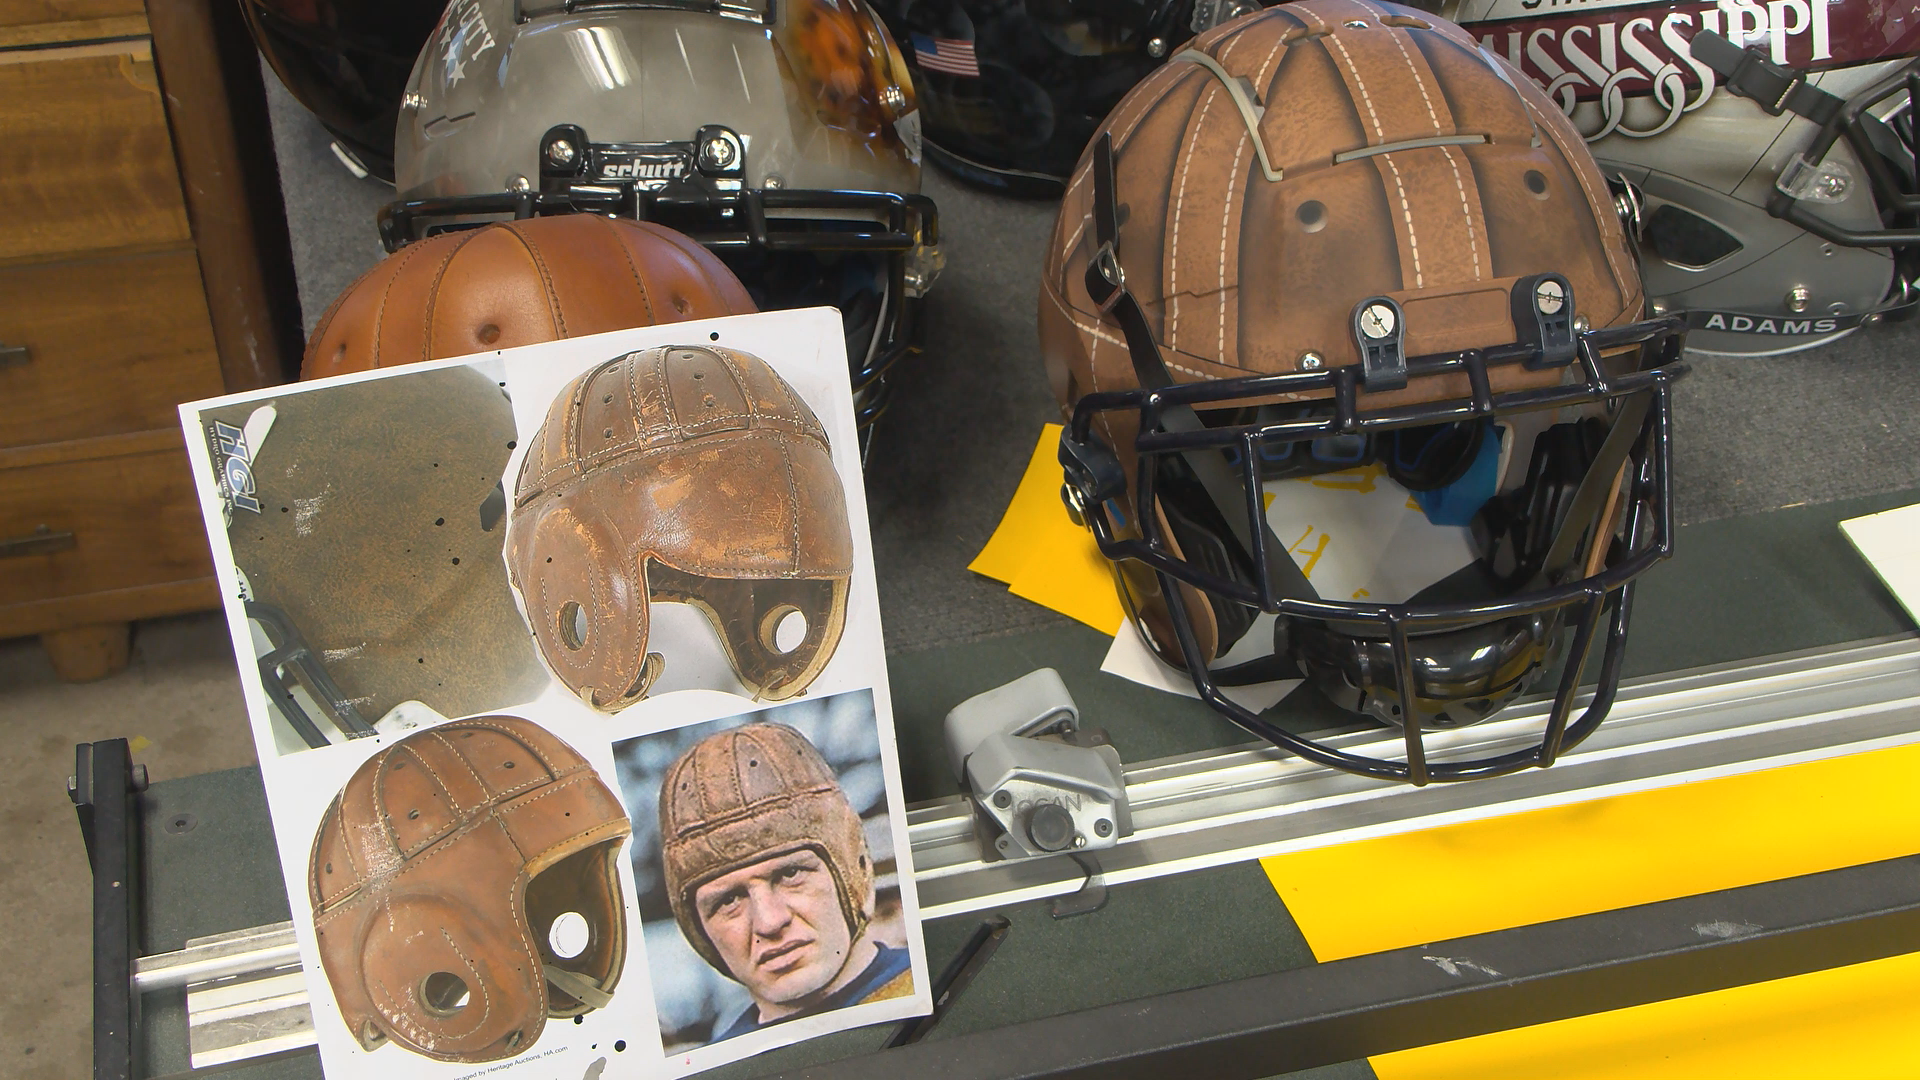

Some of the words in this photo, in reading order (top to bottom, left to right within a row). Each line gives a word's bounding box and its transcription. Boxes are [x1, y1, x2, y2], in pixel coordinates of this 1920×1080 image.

[459, 2, 495, 61] CITY
[603, 159, 685, 178] schutt
[1705, 314, 1837, 334] ADAMS
[209, 426, 220, 455] HYDRO
[216, 457, 230, 498] GRAPHICS
[214, 420, 261, 514] HGI
[487, 1062, 514, 1074] Heritage
[543, 1045, 569, 1057] HA.com
